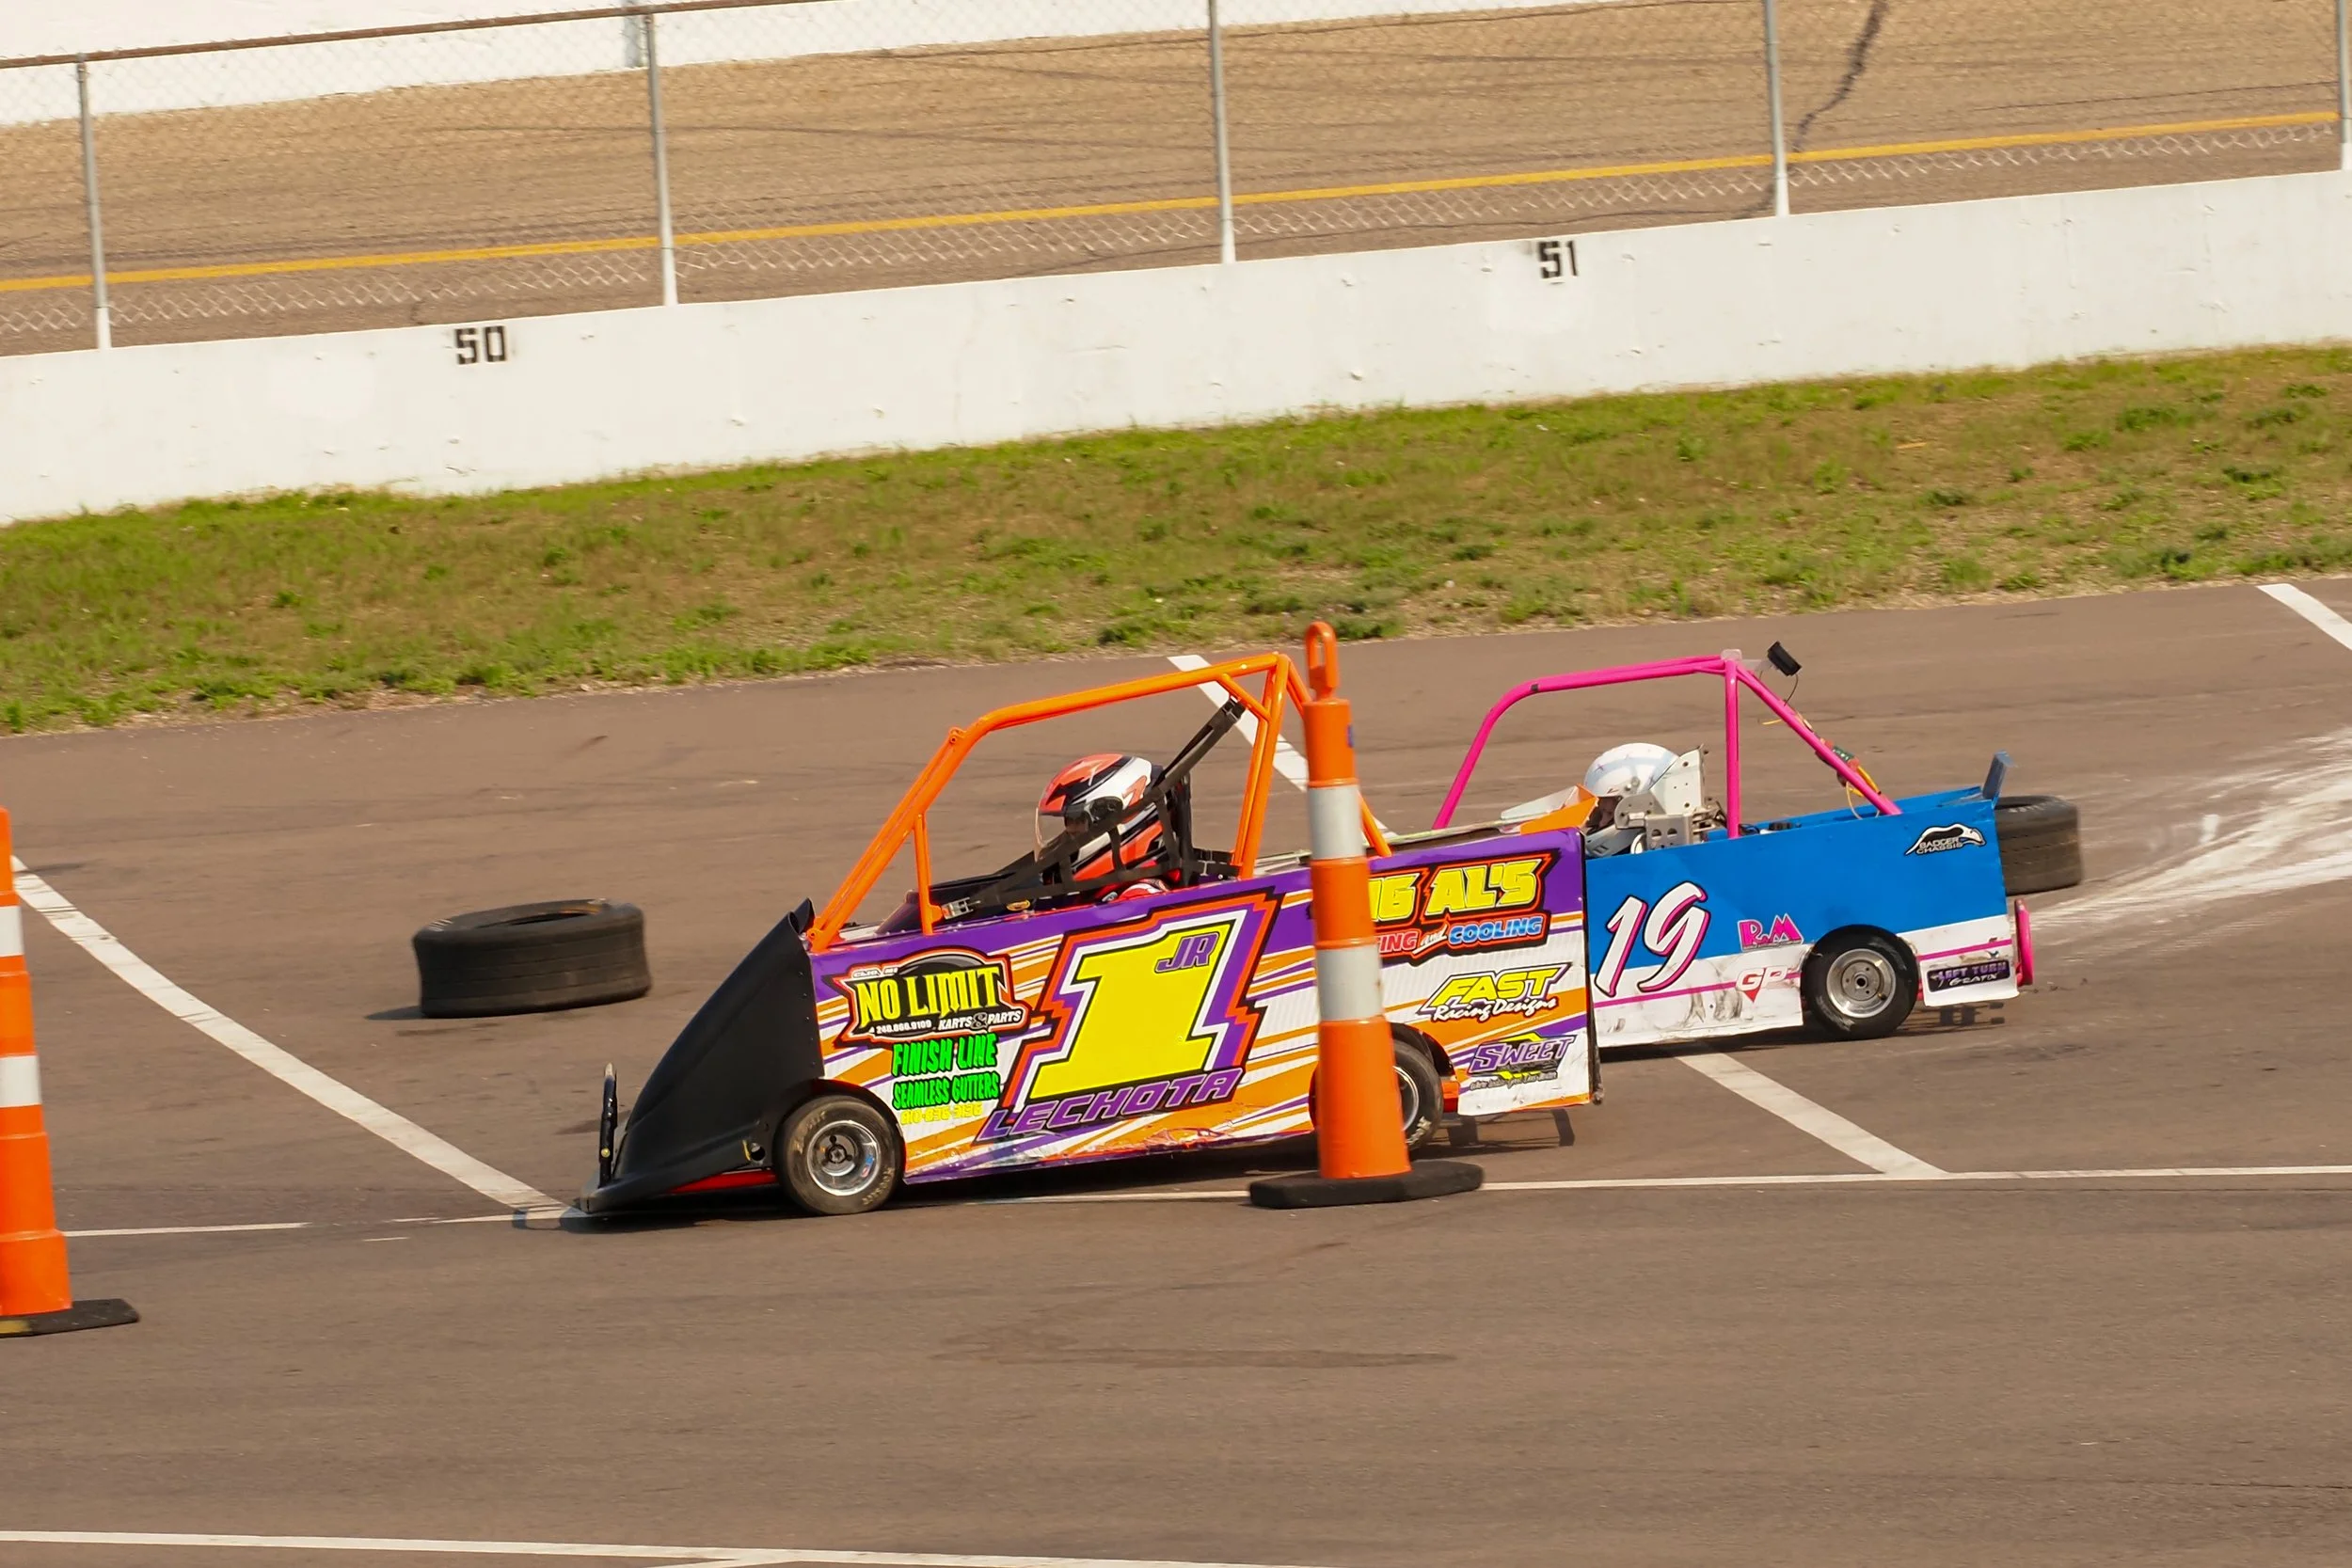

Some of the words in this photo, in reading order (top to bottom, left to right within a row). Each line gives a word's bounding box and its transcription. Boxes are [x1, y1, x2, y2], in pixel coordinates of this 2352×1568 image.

[1538, 240, 1578, 279] 51
[455, 325, 506, 365] 50
[1424, 858, 1543, 917] AL'S
[1449, 915, 1544, 944] COOLING
[1595, 881, 1711, 997] 19
[1154, 932, 1220, 973] JR
[855, 978, 902, 1028] NO
[904, 966, 1001, 1018] LIMIT
[1429, 967, 1560, 1009] FAST
[1021, 910, 1248, 1114] 1
[1433, 1005, 1491, 1022] Racing
[1492, 997, 1558, 1017] Designs
[892, 1037, 953, 1077] FINISH
[955, 1033, 998, 1070] LINE
[1469, 1037, 1573, 1073] SWEET
[892, 1081, 950, 1110] SEAMLESS
[951, 1071, 1001, 1104] GUTTERS
[978, 1067, 1244, 1140] LECHOTA
